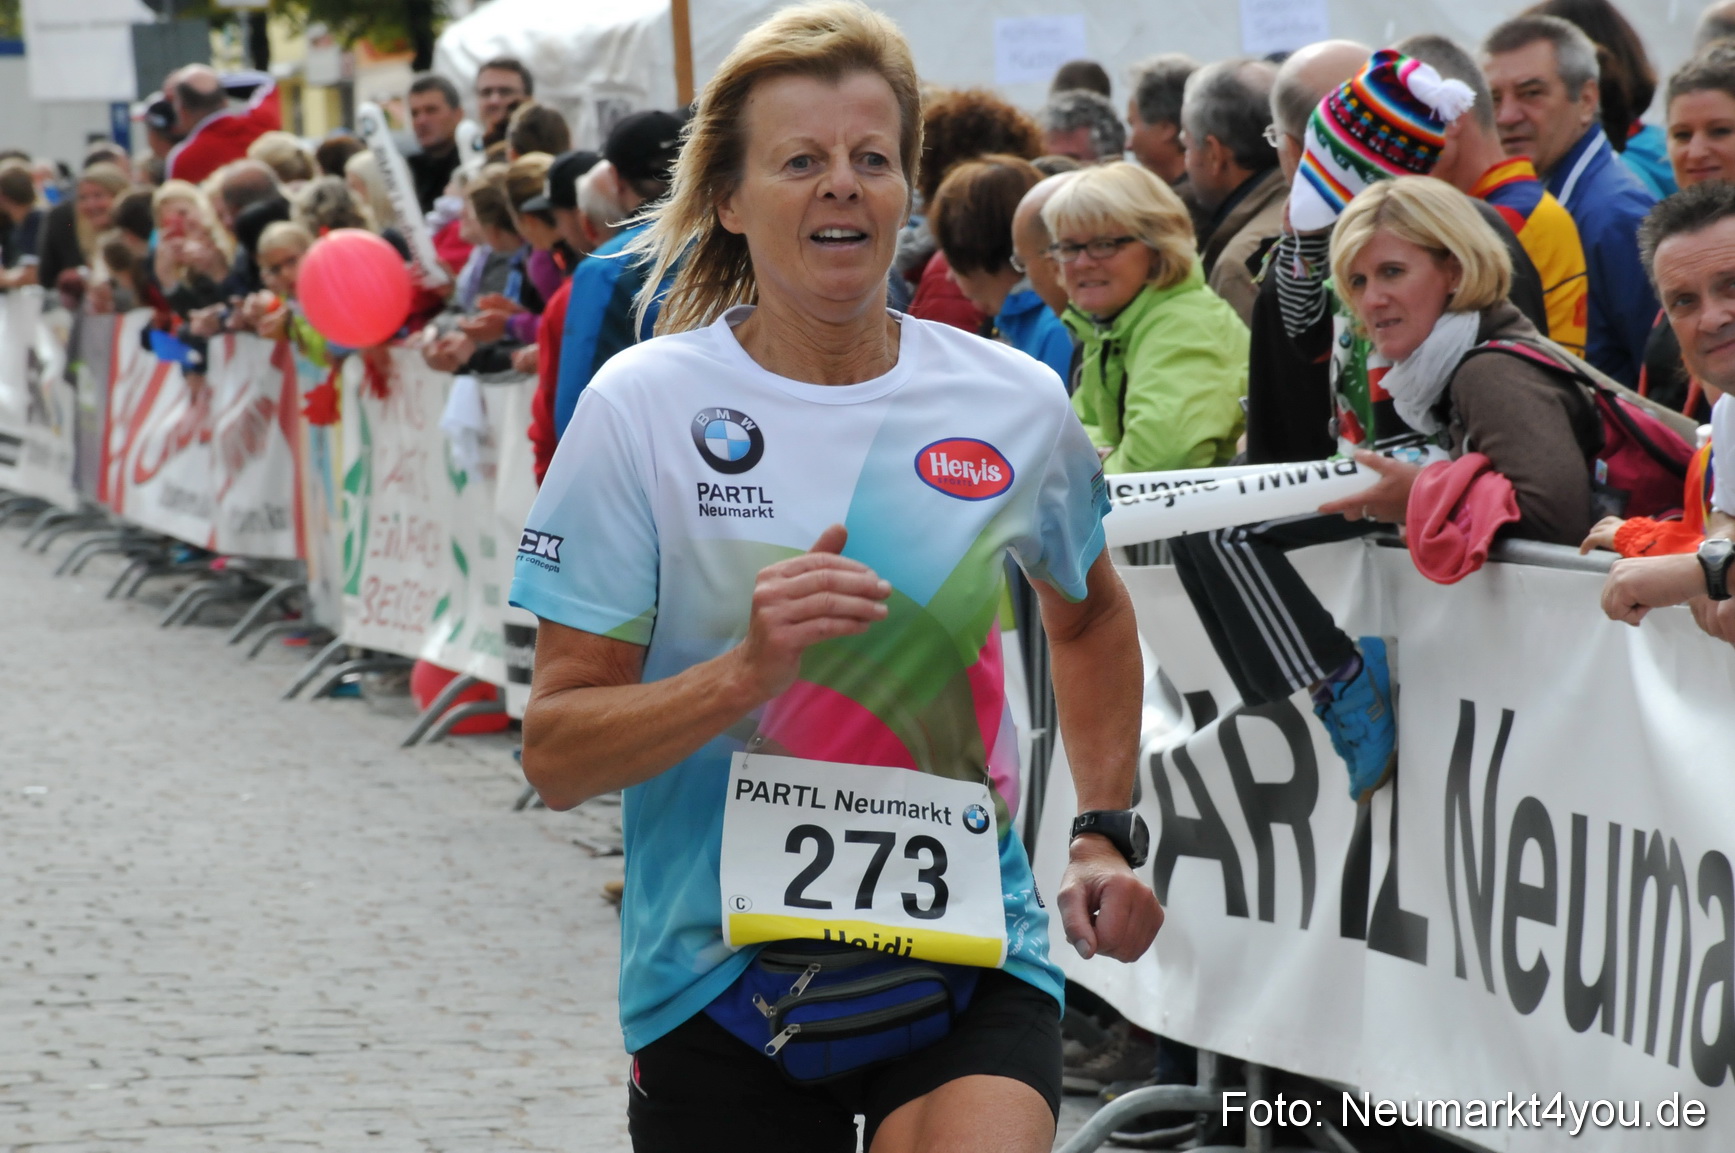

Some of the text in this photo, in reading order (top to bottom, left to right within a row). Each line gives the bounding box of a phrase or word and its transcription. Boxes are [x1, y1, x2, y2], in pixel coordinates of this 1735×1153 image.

[695, 408, 757, 432] BMW
[929, 452, 1002, 486] Hervis
[696, 482, 773, 504] PARTL
[698, 503, 775, 519] Neumarkt
[525, 556, 560, 573] concepts
[735, 778, 952, 826] PARTL Neumarkt
[1132, 685, 1429, 967] ARL
[783, 824, 949, 920] 273
